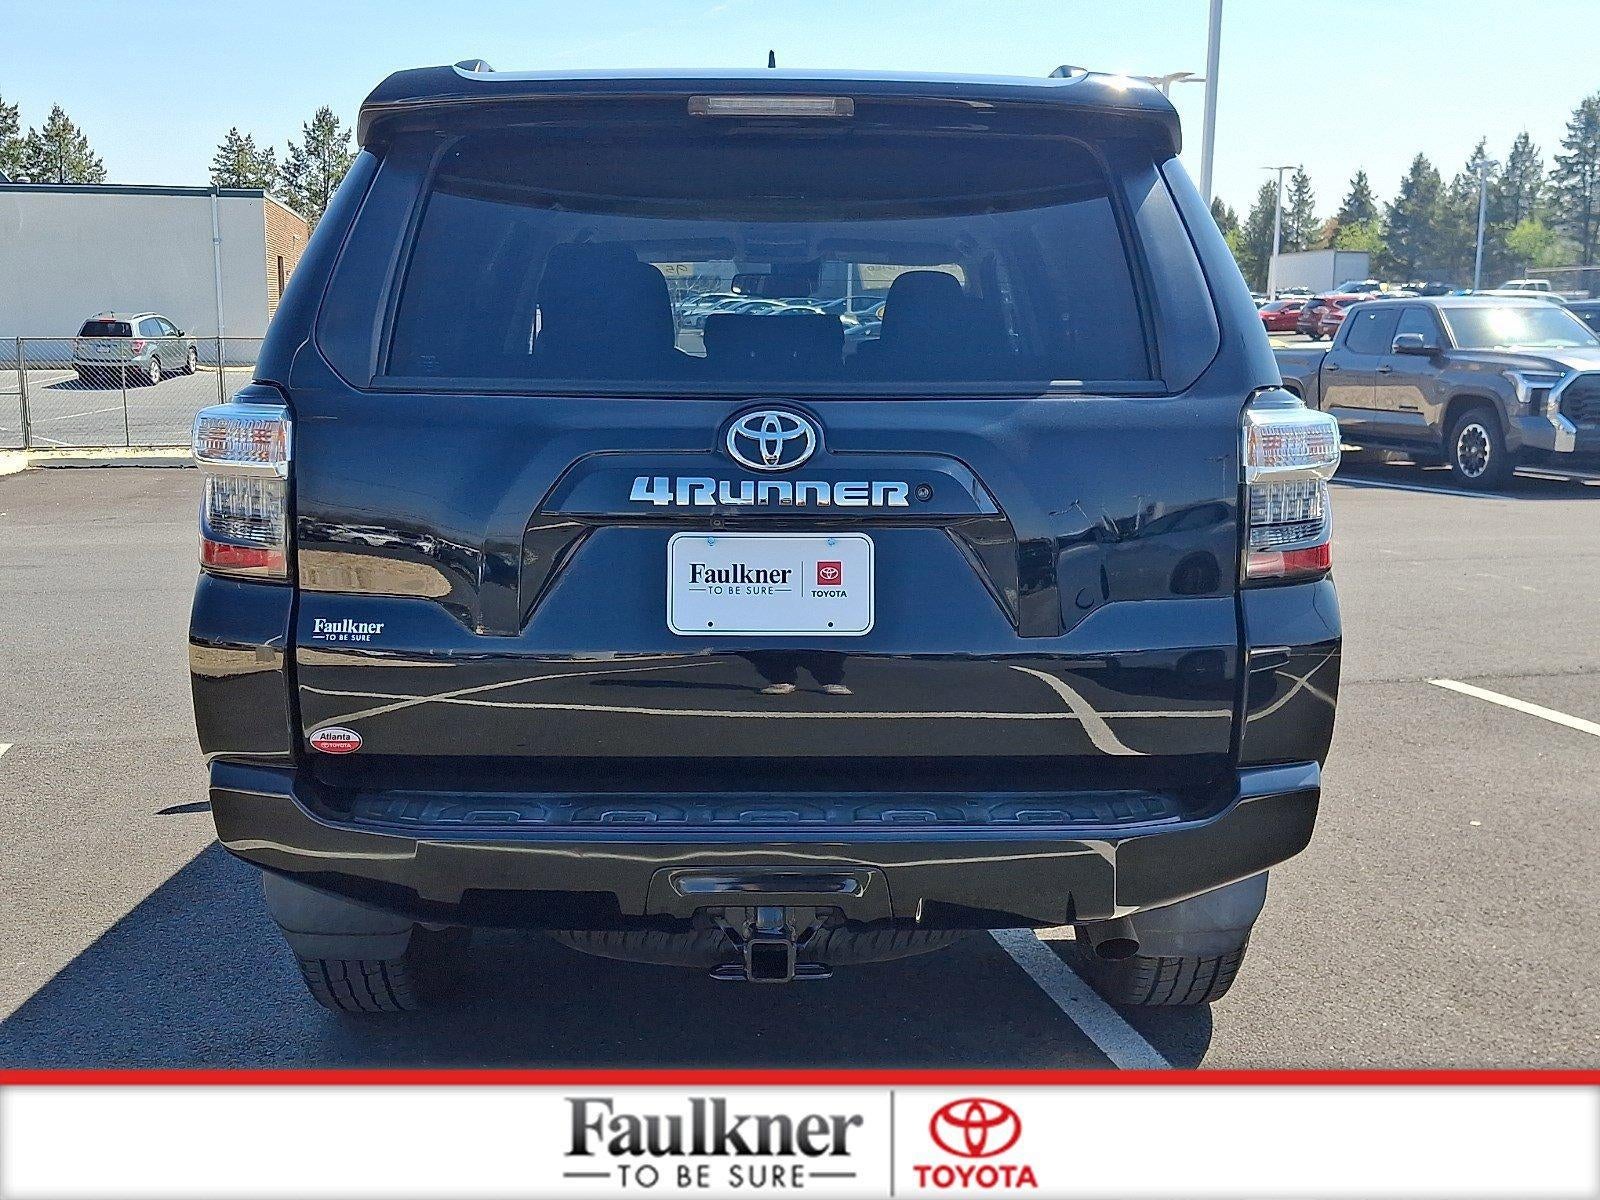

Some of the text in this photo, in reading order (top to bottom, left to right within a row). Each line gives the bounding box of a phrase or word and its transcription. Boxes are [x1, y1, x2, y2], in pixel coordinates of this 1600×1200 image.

[689, 563, 792, 584] Faulkner
[708, 586, 774, 595] TO BE SURE
[811, 590, 847, 598] TOYOTA
[312, 618, 385, 634] Faulkner
[351, 634, 371, 642] SURE
[320, 733, 351, 741] Atlanta
